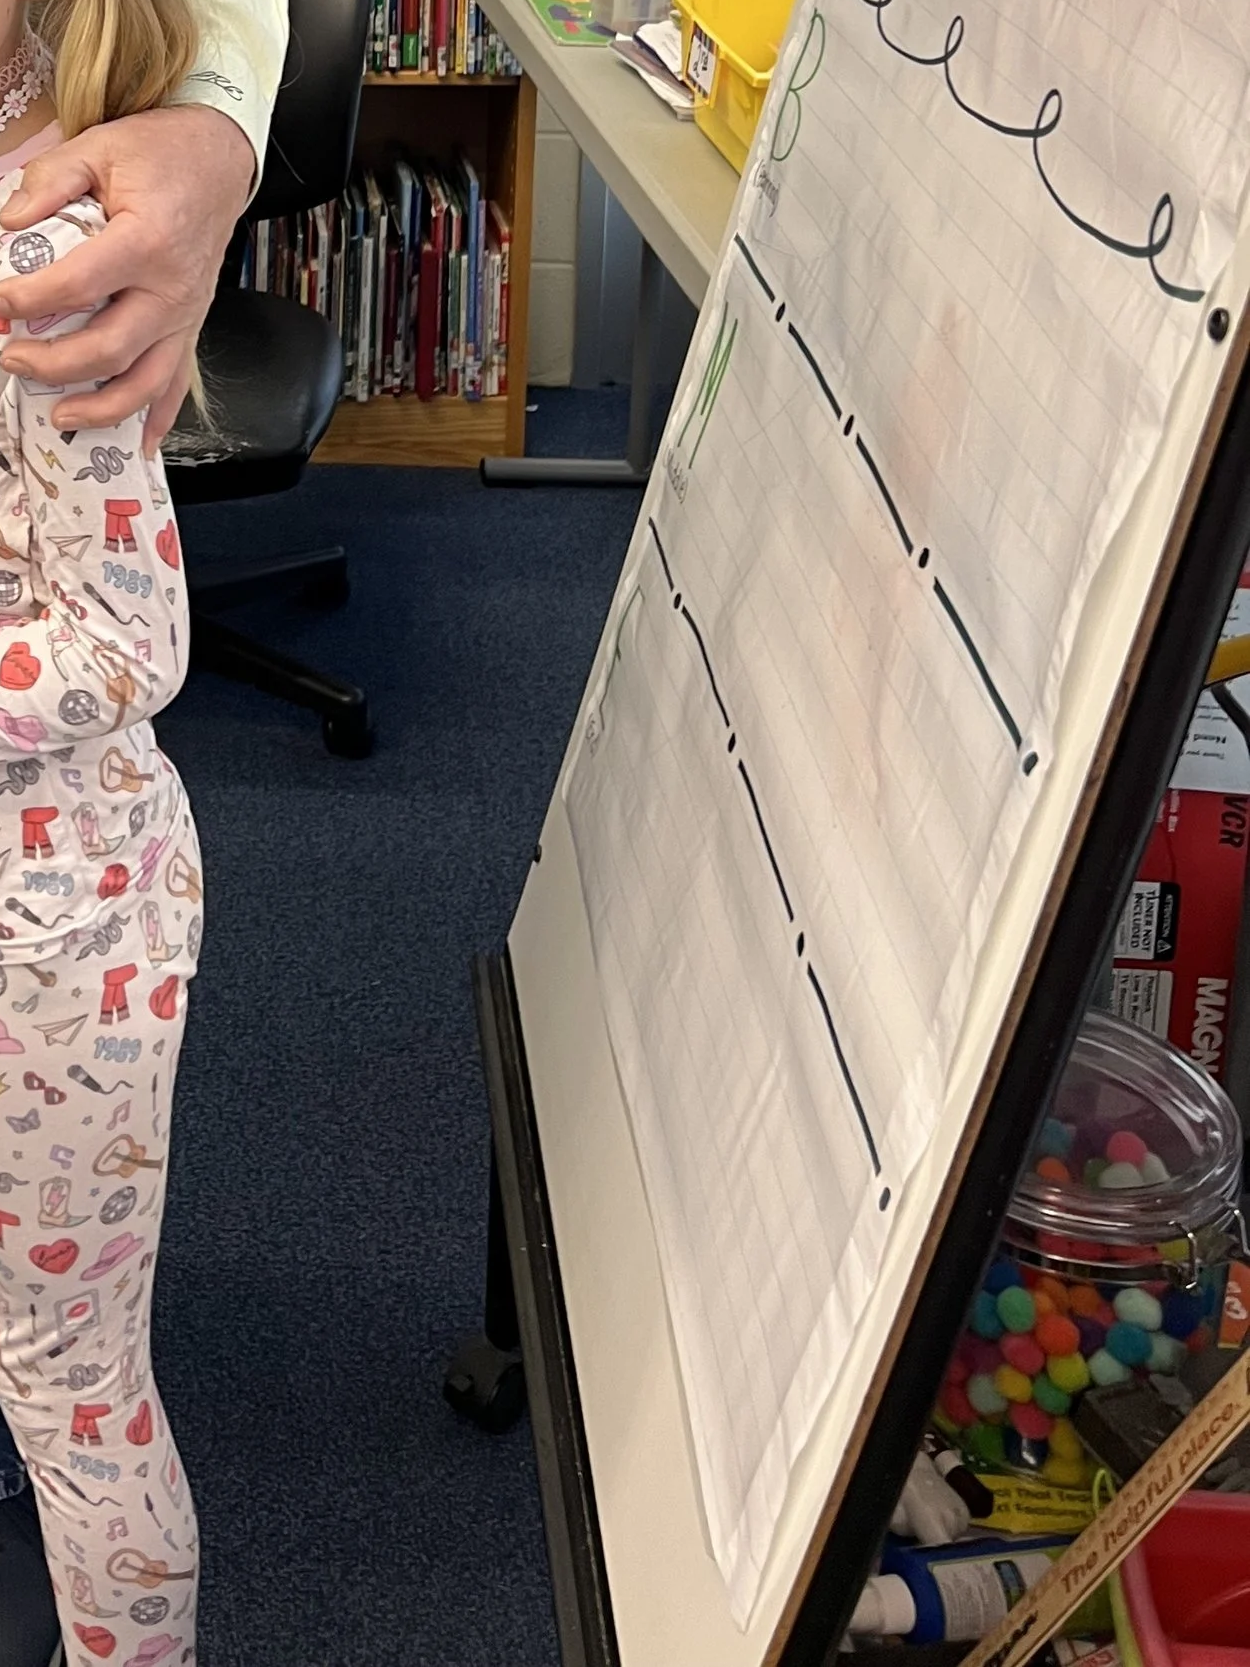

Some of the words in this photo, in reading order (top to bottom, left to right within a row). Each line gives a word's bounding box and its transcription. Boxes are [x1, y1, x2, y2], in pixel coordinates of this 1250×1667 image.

[102, 560, 153, 599] 1989
[1219, 796, 1248, 848] VCR
[22, 870, 75, 897] 1989
[1130, 893, 1144, 948] INCLUDED
[1142, 891, 1157, 927] TUNER
[1162, 894, 1174, 937] ATTENTION
[1140, 929, 1152, 953] NOT
[94, 1036, 142, 1063] 1989
[68, 1450, 120, 1482] 1989
[1060, 1550, 1098, 1594] The
[1102, 1464, 1175, 1552] helpful
